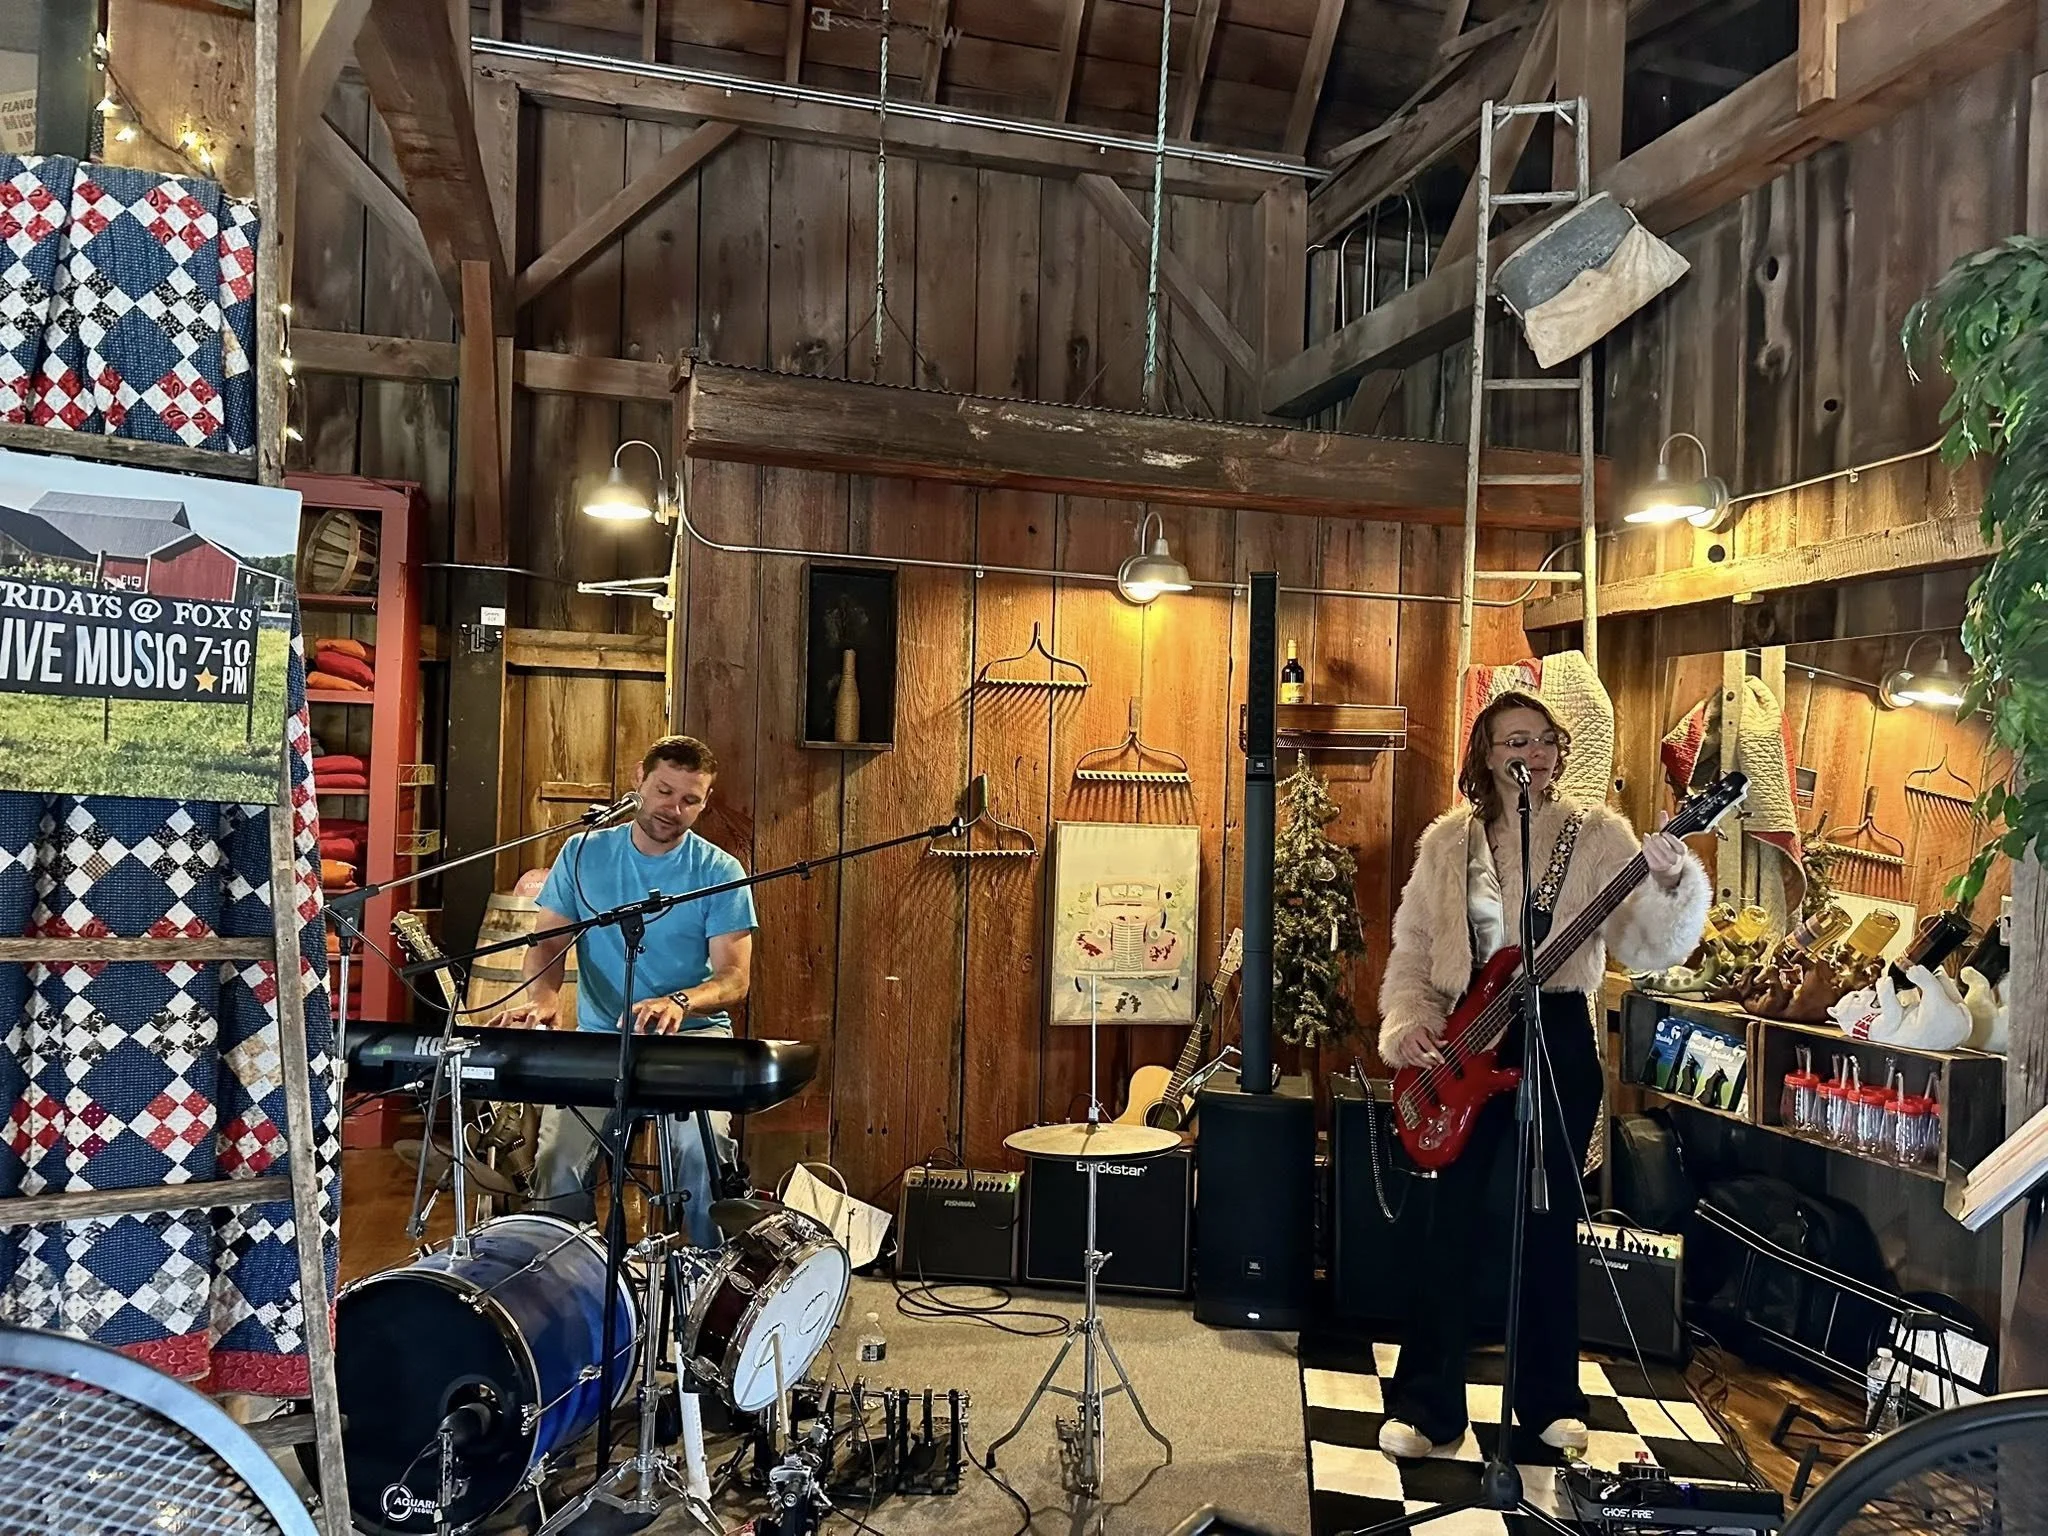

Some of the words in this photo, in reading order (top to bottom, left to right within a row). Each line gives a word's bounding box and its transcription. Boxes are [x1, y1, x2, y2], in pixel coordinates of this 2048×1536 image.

[0, 580, 122, 619] RIDAYS
[129, 598, 162, 623] @
[173, 602, 252, 630] FOX'S
[75, 625, 187, 690] MUSIC
[194, 636, 251, 667] 7-10
[221, 666, 247, 694] PM
[414, 1036, 472, 1058] KO
[1602, 1507, 1630, 1518] GHOST
[1631, 1510, 1652, 1519] FIRE
